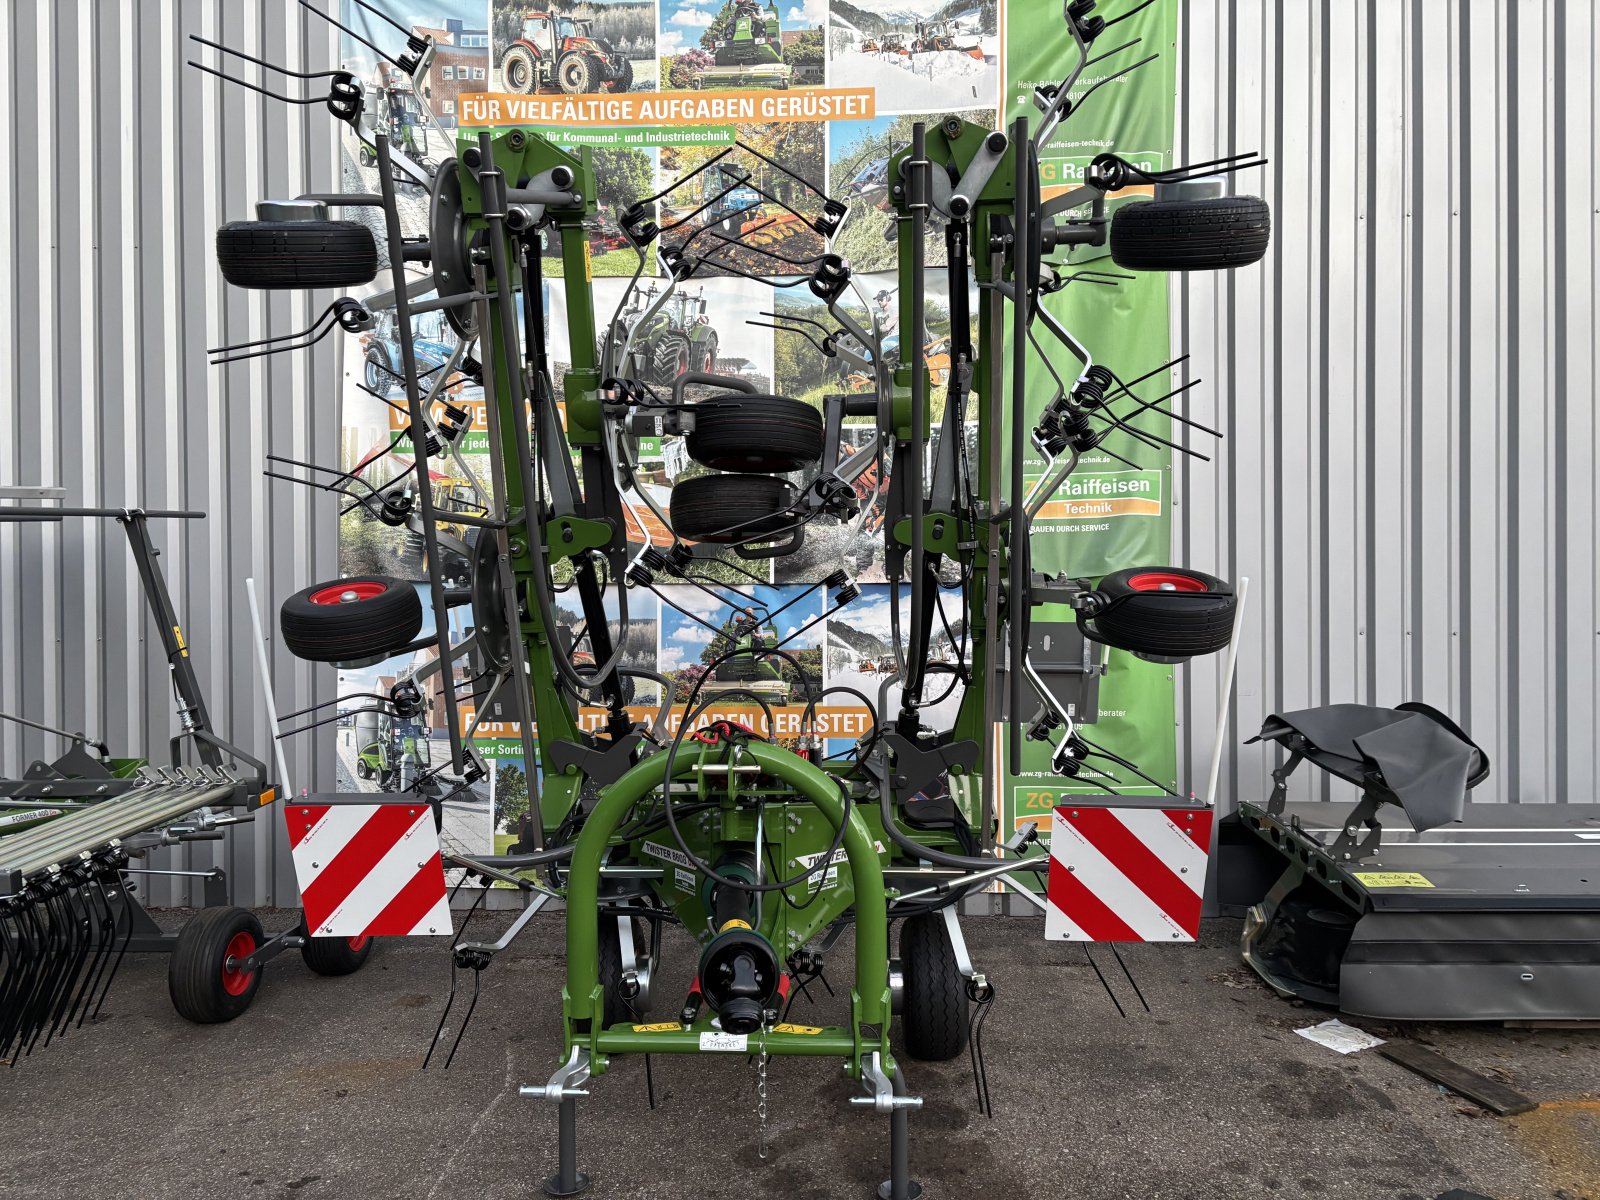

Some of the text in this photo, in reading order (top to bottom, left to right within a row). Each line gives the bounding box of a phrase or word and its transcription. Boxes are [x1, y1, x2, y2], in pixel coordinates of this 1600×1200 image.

[463, 91, 870, 121] FÜR VIELFÄLTIGE AUFGABEN GERÜSTET
[546, 131, 730, 143] für Kommunal- und Industrietechnik
[1058, 477, 1151, 496] Raiffeisen
[1063, 502, 1113, 515] Technik
[1056, 525, 1080, 533] DURCH
[1081, 523, 1110, 532] SERVICE
[1026, 791, 1054, 809] ZG
[11, 811, 38, 823] FORMER
[645, 842, 673, 861] TWISTER
